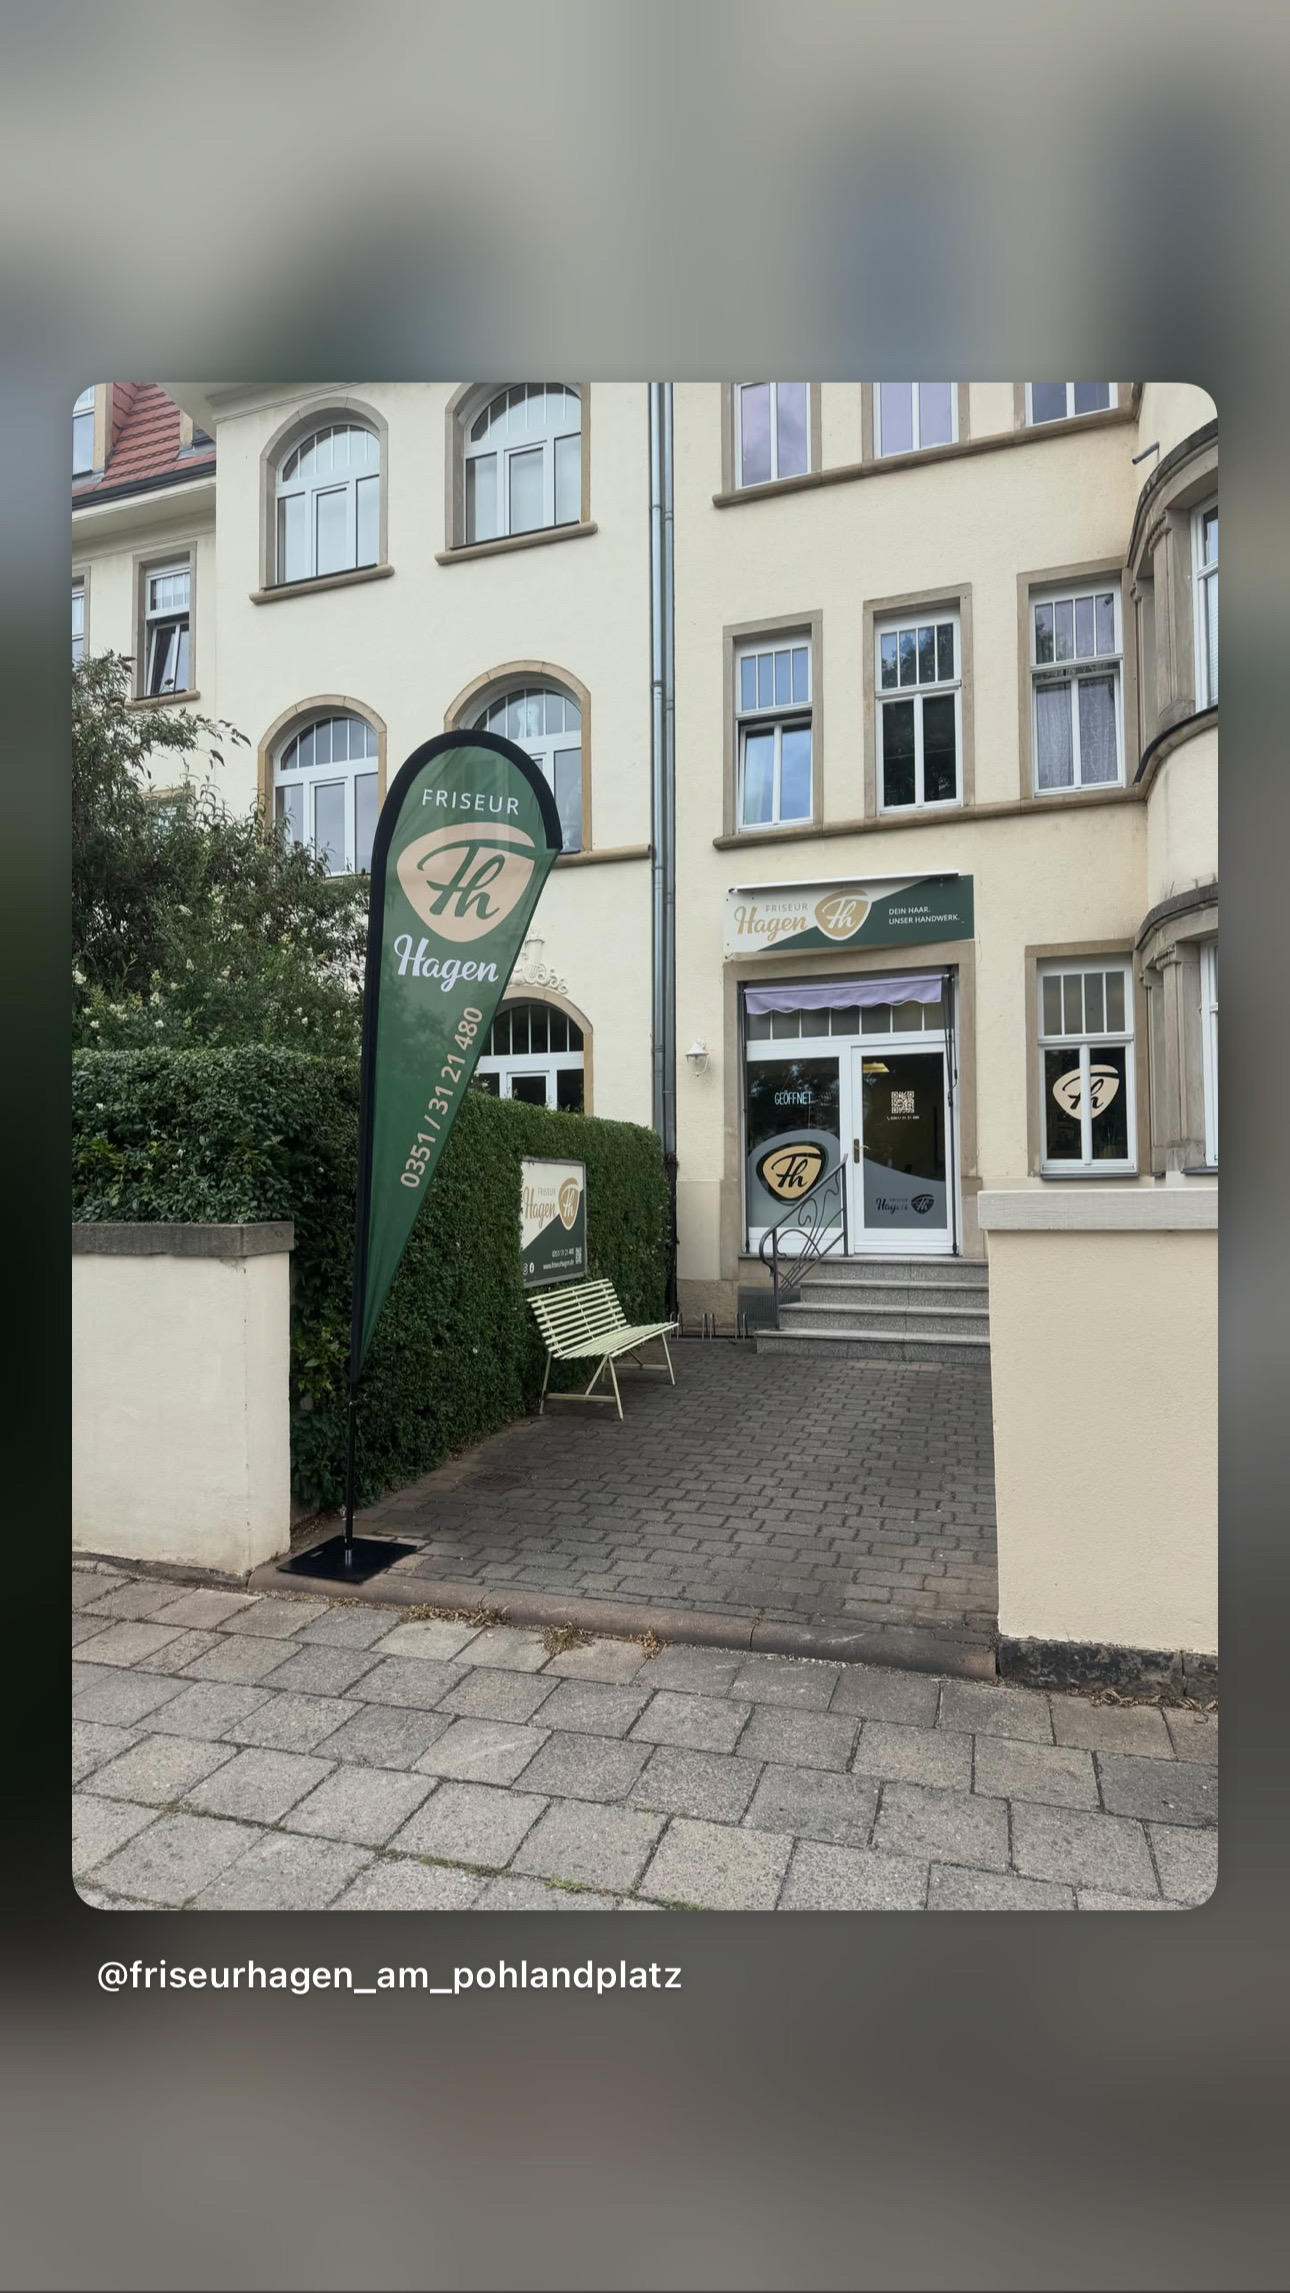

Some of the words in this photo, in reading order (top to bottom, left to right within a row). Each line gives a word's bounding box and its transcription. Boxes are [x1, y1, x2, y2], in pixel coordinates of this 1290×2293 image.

[422, 789, 519, 816] FRISEUR
[765, 902, 809, 913] FRISEUR
[888, 907, 907, 916] DEIN
[908, 905, 931, 915] HAAR.
[888, 916, 914, 926] UNSER
[915, 913, 961, 924] HANDWERK.
[733, 905, 809, 942] Hagen
[393, 933, 499, 993] Hagen
[454, 1006, 484, 1051] 480
[441, 1053, 467, 1084] 21
[428, 1085, 454, 1116] 31
[774, 1089, 812, 1106] GEÖFFNET
[423, 1113, 442, 1131] /
[400, 1132, 437, 1189] 0351
[522, 1185, 556, 1230] Hagen
